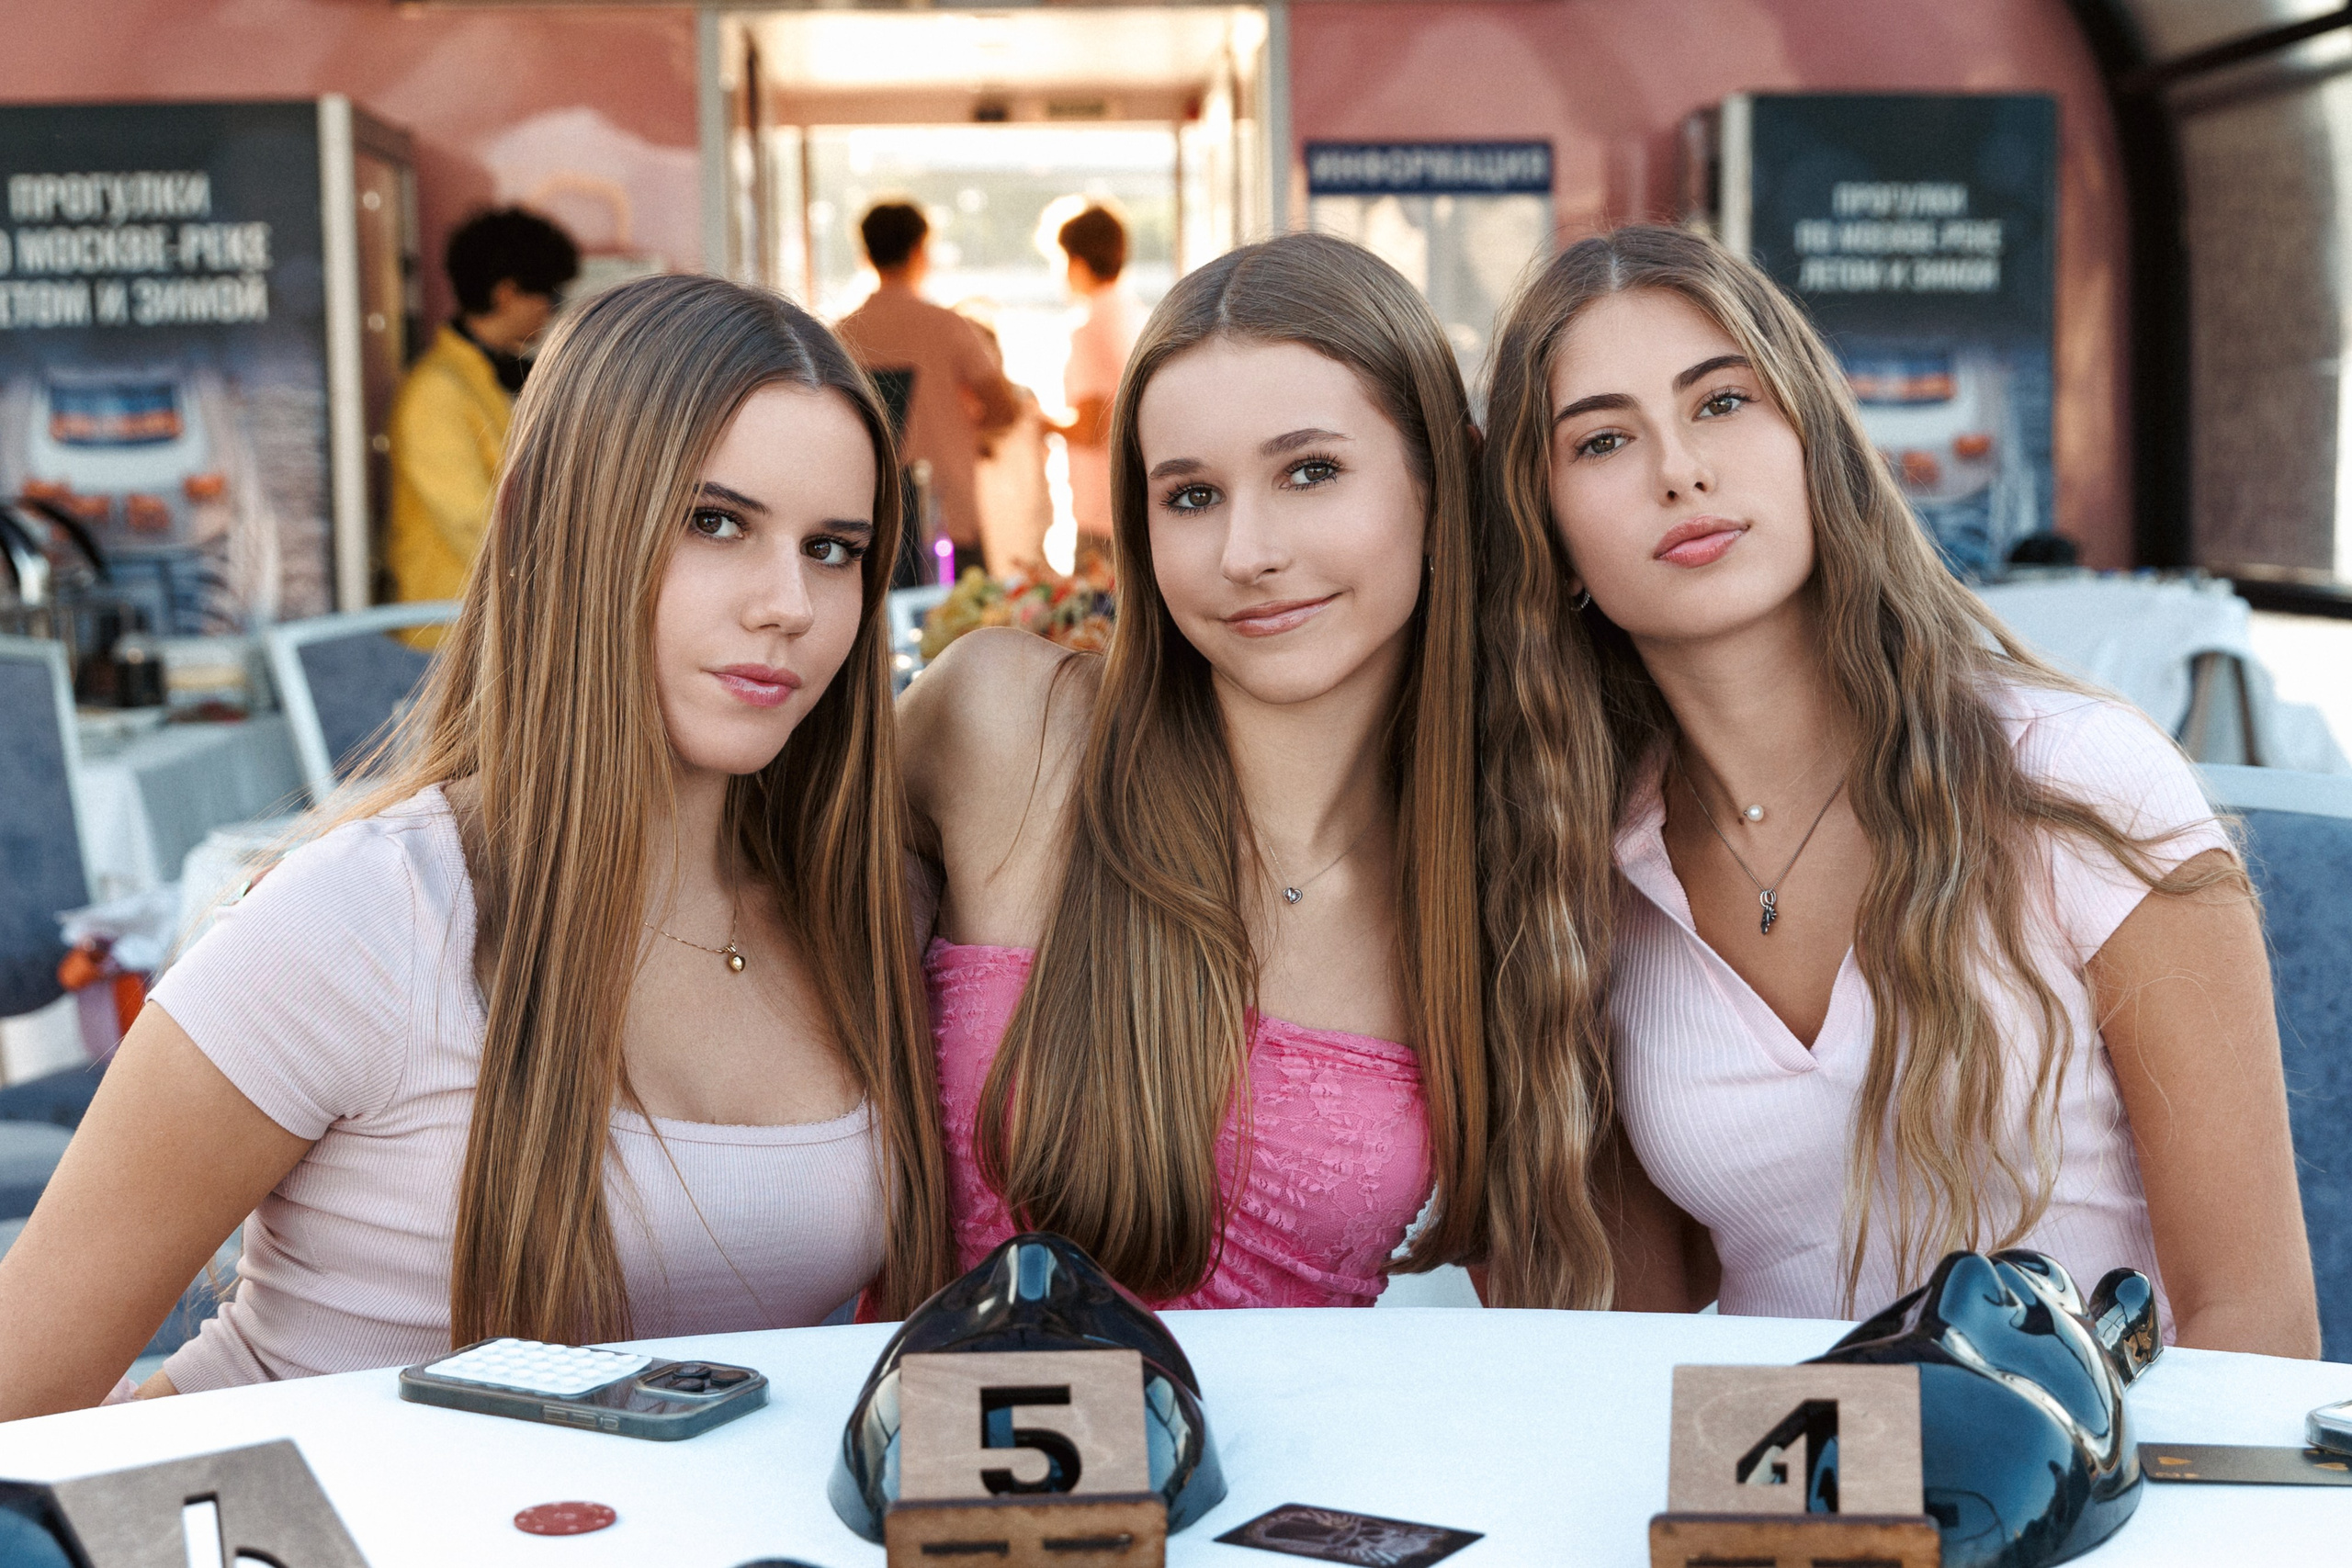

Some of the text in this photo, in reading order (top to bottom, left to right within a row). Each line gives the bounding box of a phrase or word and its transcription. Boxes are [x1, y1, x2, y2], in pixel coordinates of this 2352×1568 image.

[1311, 150, 1548, 185] ИНФОРМАЦИЯ
[9, 171, 210, 225] ПРОГУЛКИ
[1832, 182, 1966, 217] ПРОГУЛКИ
[16, 222, 270, 274] МОСКВЕ-РЕКЕ
[1798, 256, 1999, 291] ЛЕТОМ И ЗИМОЙ
[0, 272, 268, 329] ЕТОМ И ЗИМОЙ
[980, 1384, 1081, 1495] 5
[1736, 1399, 1838, 1514] 4
